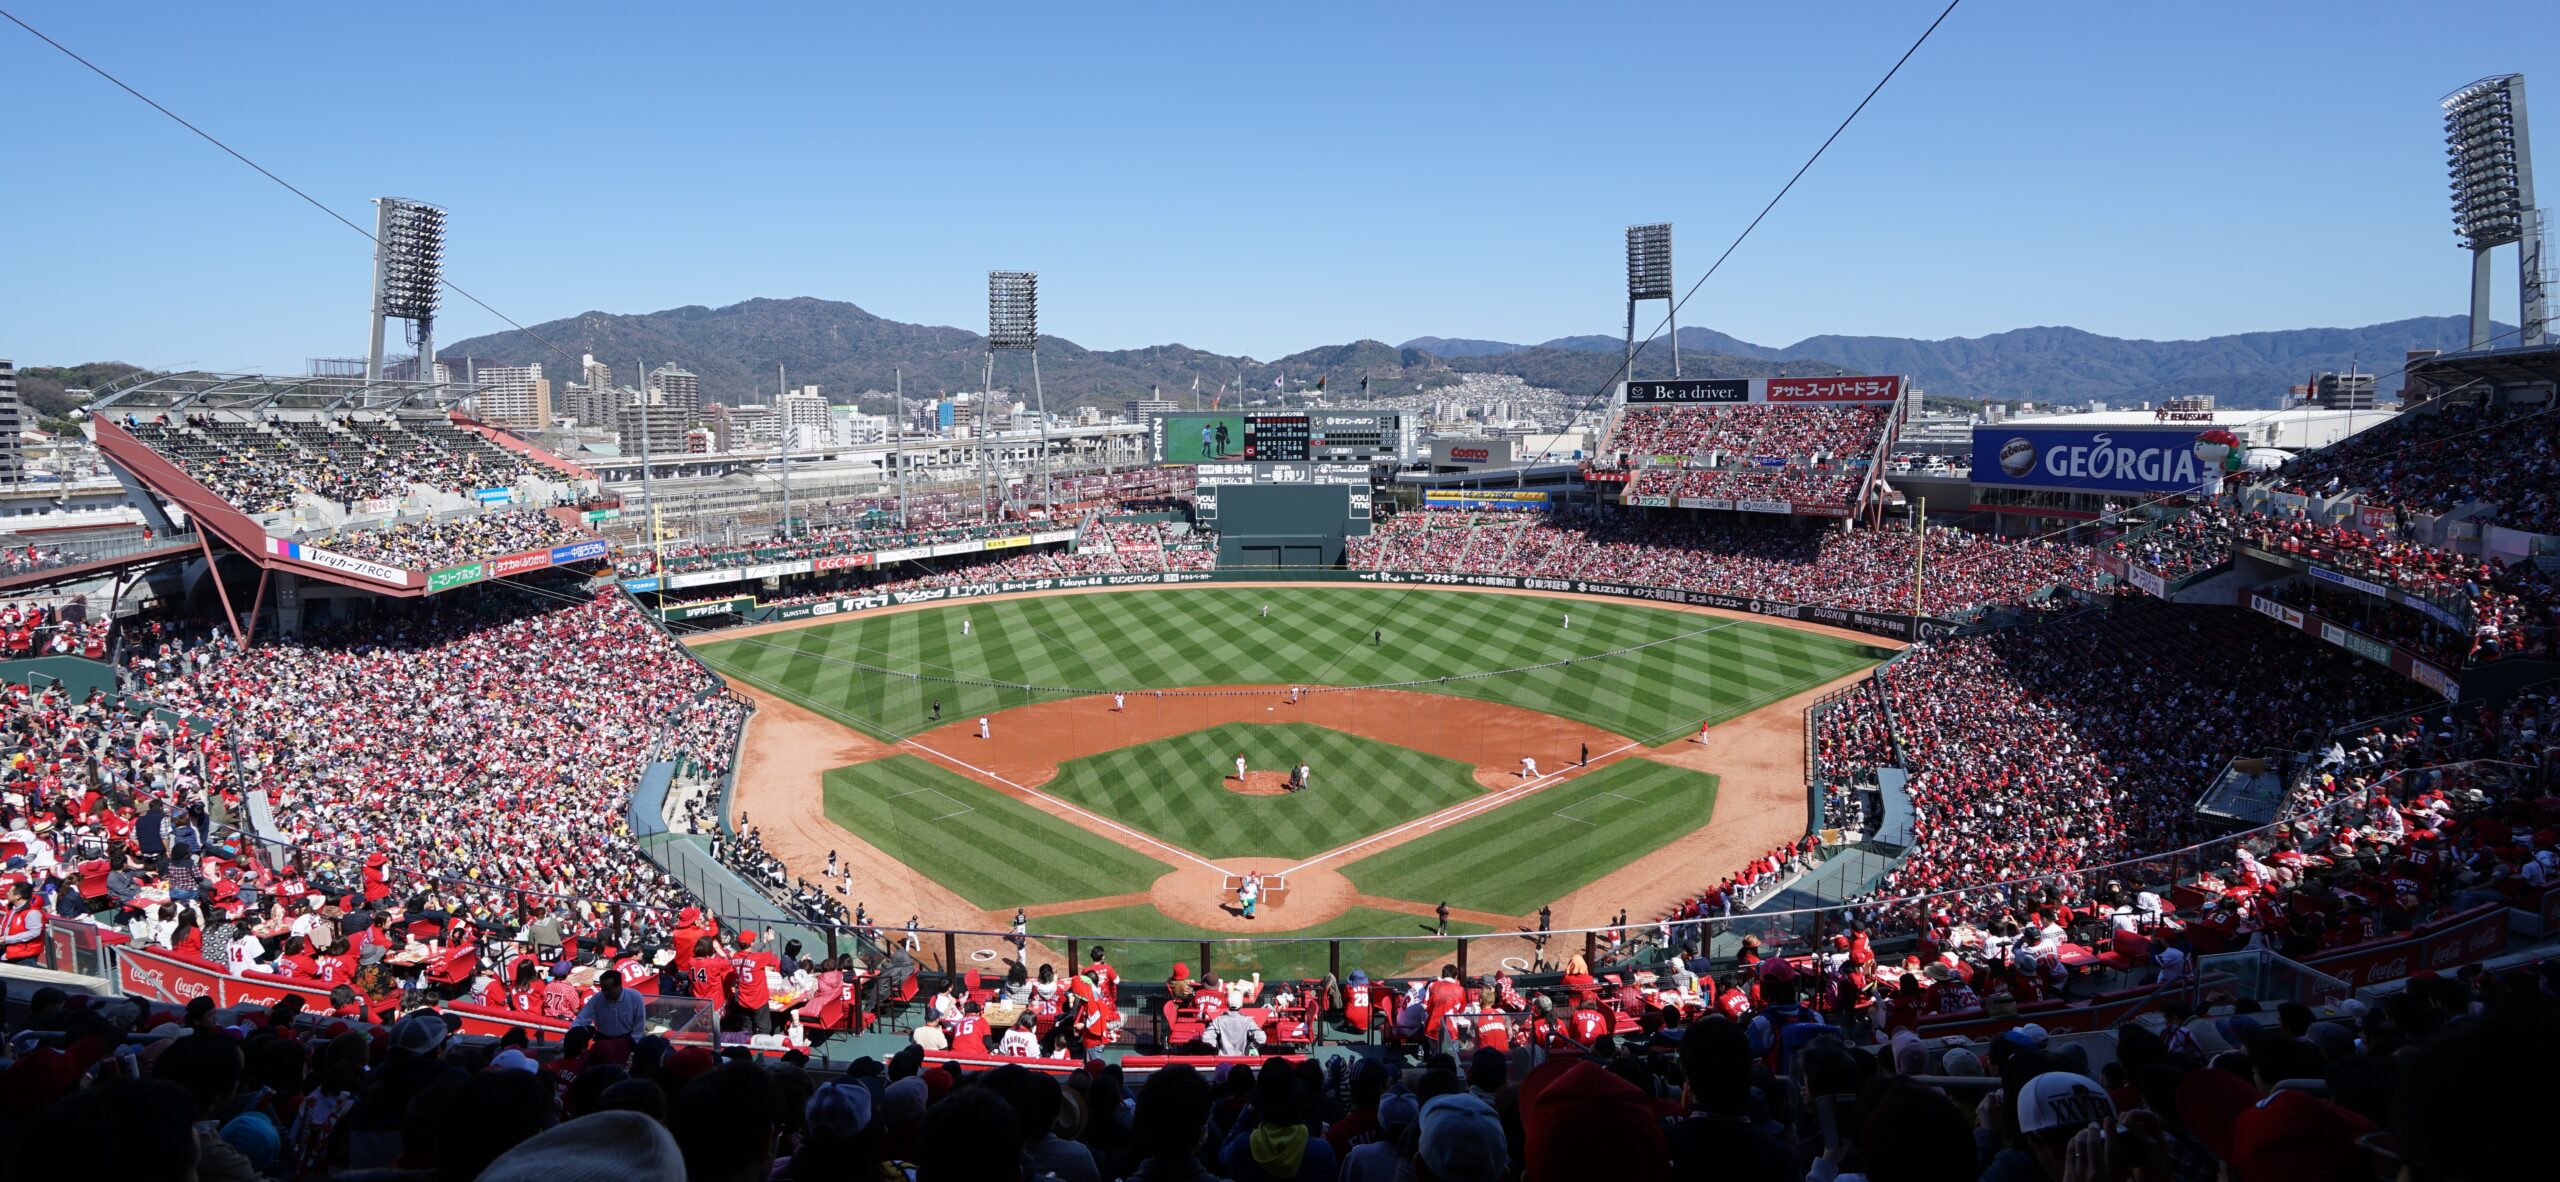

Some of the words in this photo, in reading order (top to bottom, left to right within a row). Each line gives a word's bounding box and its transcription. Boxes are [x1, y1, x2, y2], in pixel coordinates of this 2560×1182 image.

[1655, 386, 1674, 399] Be
[1679, 390, 1686, 399] a
[1691, 385, 1738, 398] driver.
[1772, 386, 1804, 397] アサヒ
[1805, 382, 1892, 396] スーパードライ
[2170, 413, 2213, 421] RENAISSANCE
[1153, 418, 1162, 461] アサヒビール
[1451, 448, 1488, 458] COSTCO
[2000, 444, 2032, 460] GEORGIA
[2045, 434, 2196, 483] GEORGIA
[1261, 470, 1305, 482] 一番搾り
[1328, 475, 1369, 484] kitagawa
[1197, 494, 1214, 503] you
[1351, 494, 1368, 503] you
[1639, 497, 1665, 505] オタフク
[1700, 500, 1731, 508] もみじ銀行
[818, 554, 869, 570] CGCグループ
[367, 566, 392, 579] RCC
[1109, 574, 1160, 583] キリンビバレッジ
[1424, 574, 1464, 583] フマキラー
[960, 582, 999, 596] ユウベル
[1059, 578, 1086, 588] Fukuya
[1589, 585, 1630, 595] SUZUKI
[842, 594, 889, 612] クマヒラ
[783, 608, 810, 618] SUNSTAR
[1763, 603, 1799, 618] 五洋建設
[1814, 609, 1848, 621] DUSKIN
[229, 947, 243, 963] 14
[324, 966, 333, 982] 9
[690, 967, 707, 983] 14
[518, 994, 530, 1010] 9
[546, 992, 563, 1011] 27
[1354, 993, 1369, 1007] 28
[1577, 1011, 1601, 1021] SLYLY
